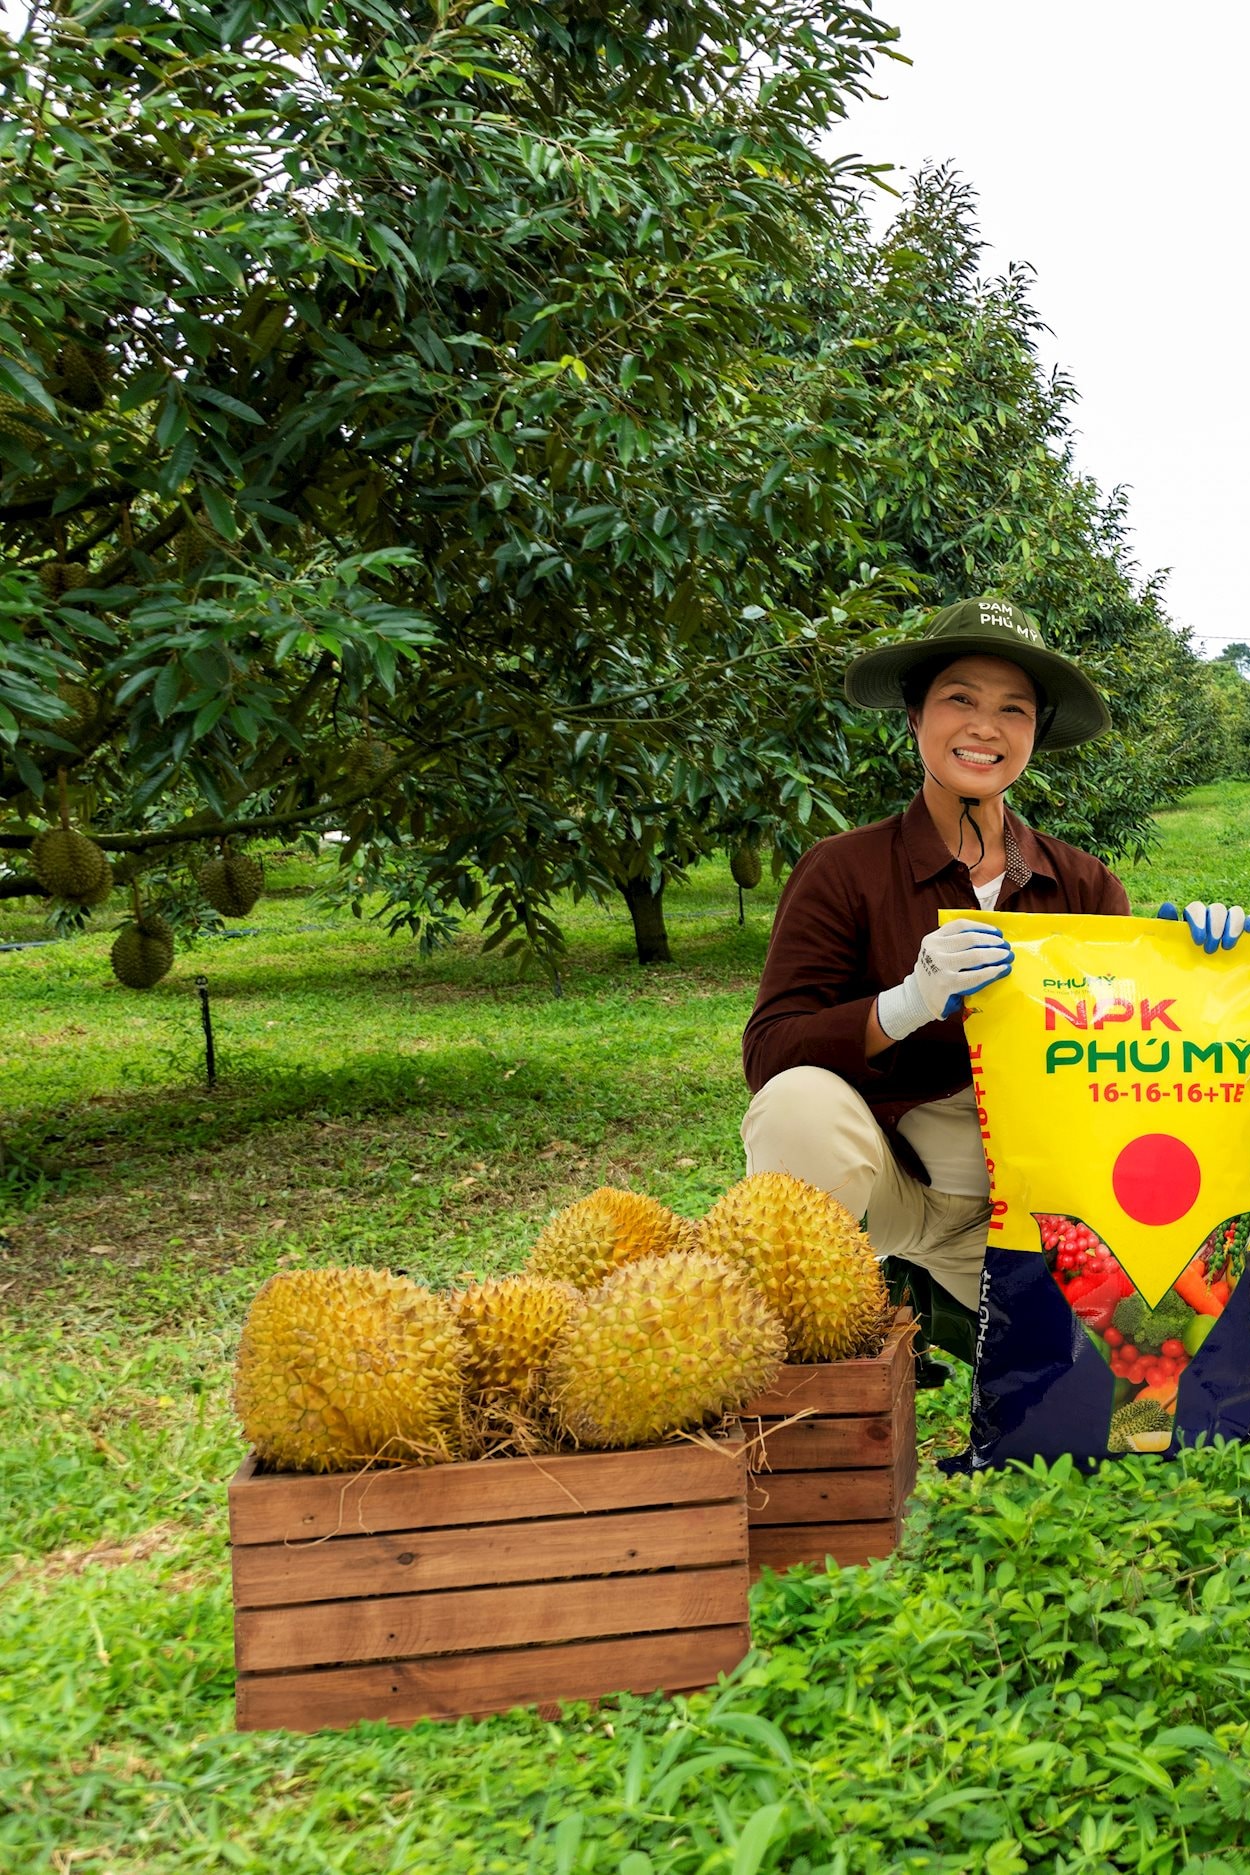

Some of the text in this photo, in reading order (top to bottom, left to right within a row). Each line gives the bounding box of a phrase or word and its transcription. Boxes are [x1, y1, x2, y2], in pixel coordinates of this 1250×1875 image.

[978, 602, 1013, 617] ĐẠM
[980, 613, 1038, 641] PHÚ MỸ
[1044, 996, 1182, 1032] NPK
[1046, 1038, 1170, 1074] PHÚ
[1088, 1082, 1246, 1103] 16-16-16+TE
